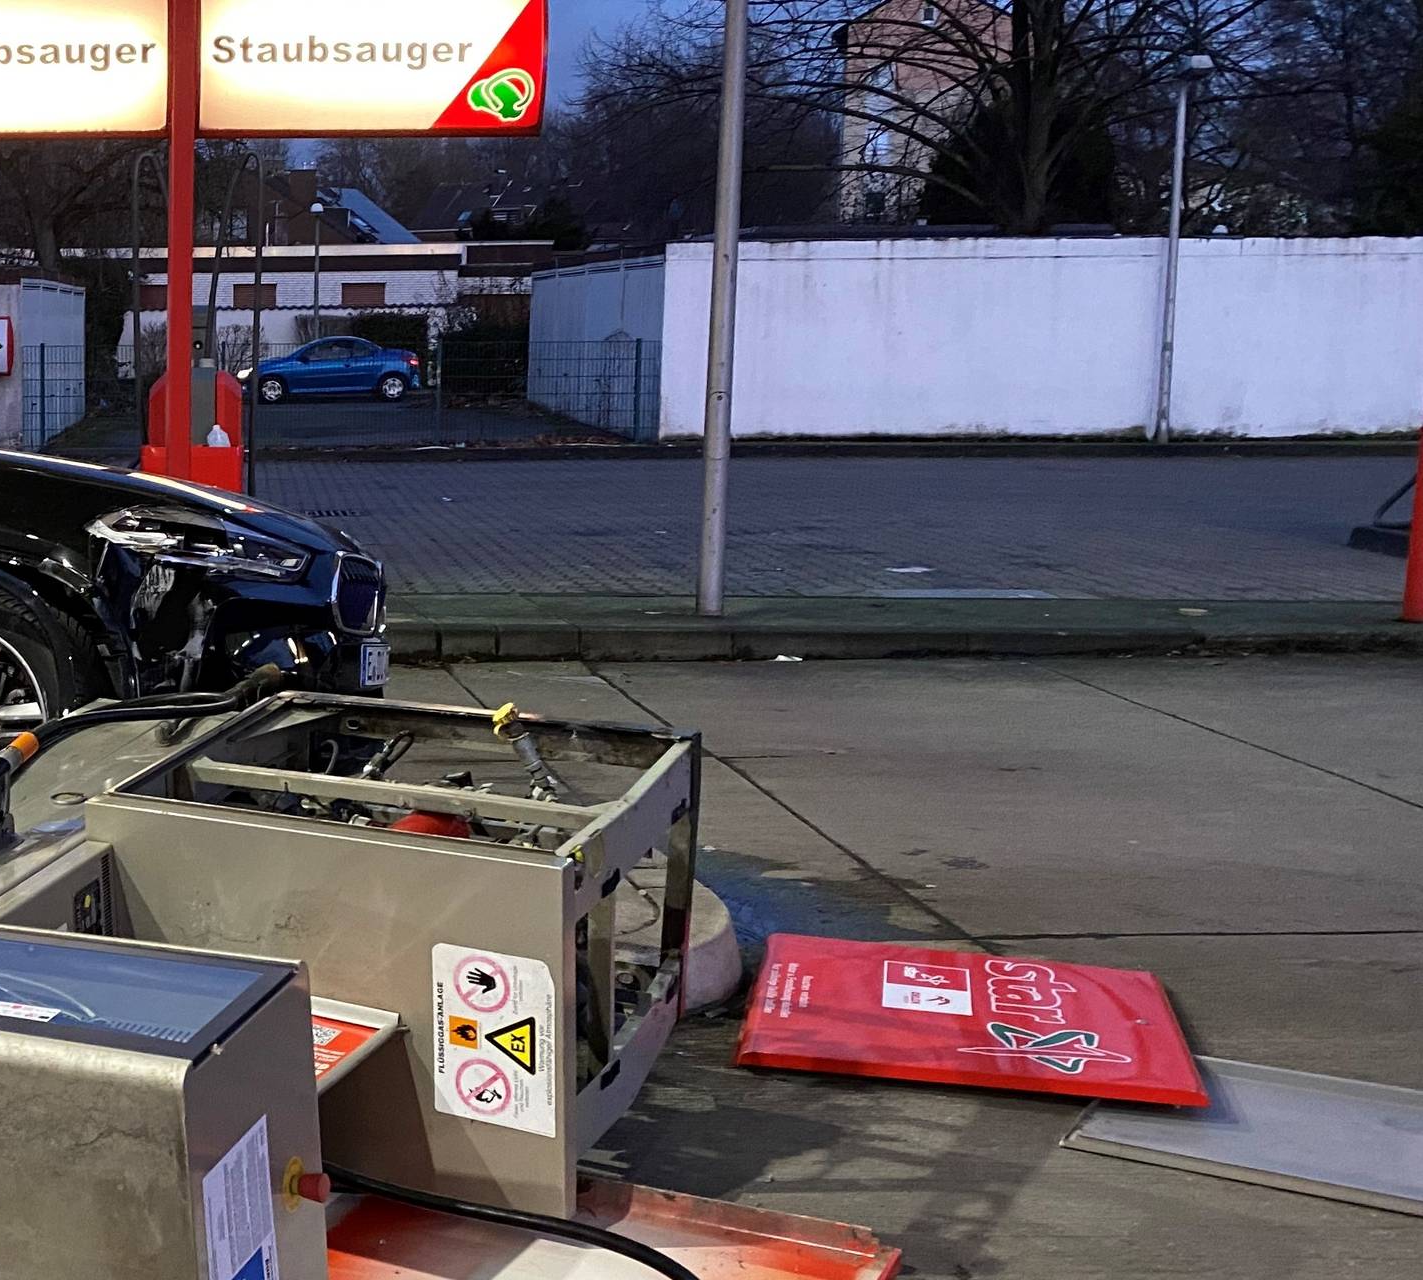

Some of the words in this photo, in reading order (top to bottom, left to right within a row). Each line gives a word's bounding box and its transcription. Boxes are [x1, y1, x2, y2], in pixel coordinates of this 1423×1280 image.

[212, 35, 473, 70] Staubsauger
[985, 959, 1078, 1025] star
[436, 981, 446, 1074] FLÜSSIGGAS-ANLAGE
[544, 993, 553, 1039] Atmosphäre
[510, 1033, 526, 1053] EX
[538, 1038, 546, 1072] Warnung
